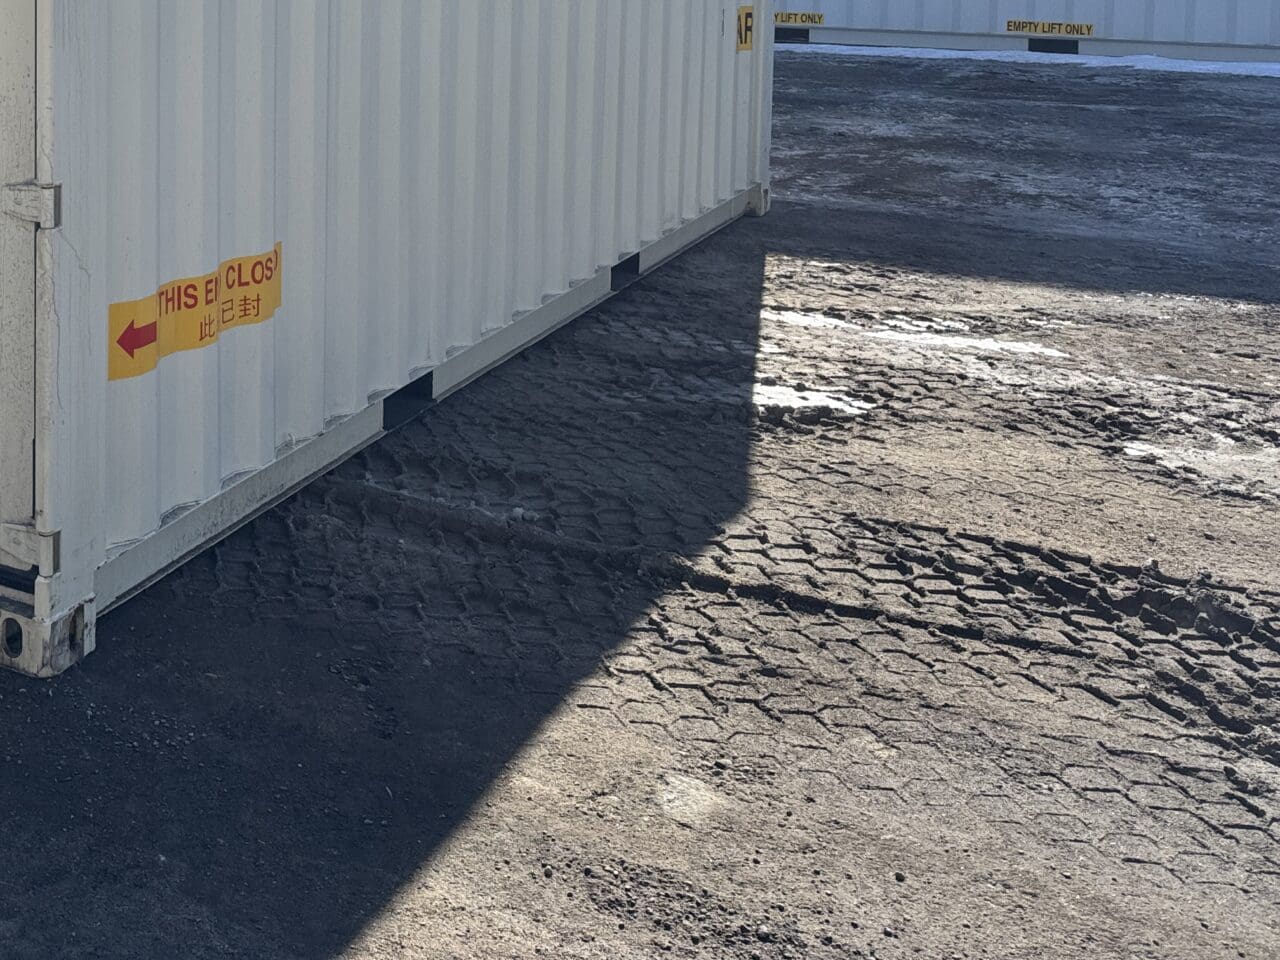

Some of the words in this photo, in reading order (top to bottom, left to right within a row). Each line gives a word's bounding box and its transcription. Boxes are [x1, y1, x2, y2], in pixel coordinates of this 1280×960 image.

[781, 13, 798, 23] LIFT
[801, 13, 823, 24] ONLY
[1007, 21, 1039, 32] EMPTY
[1042, 22, 1063, 33] LIFT
[1065, 24, 1093, 35] ONLY
[158, 283, 199, 317] THIS
[226, 249, 278, 289] CLOS
